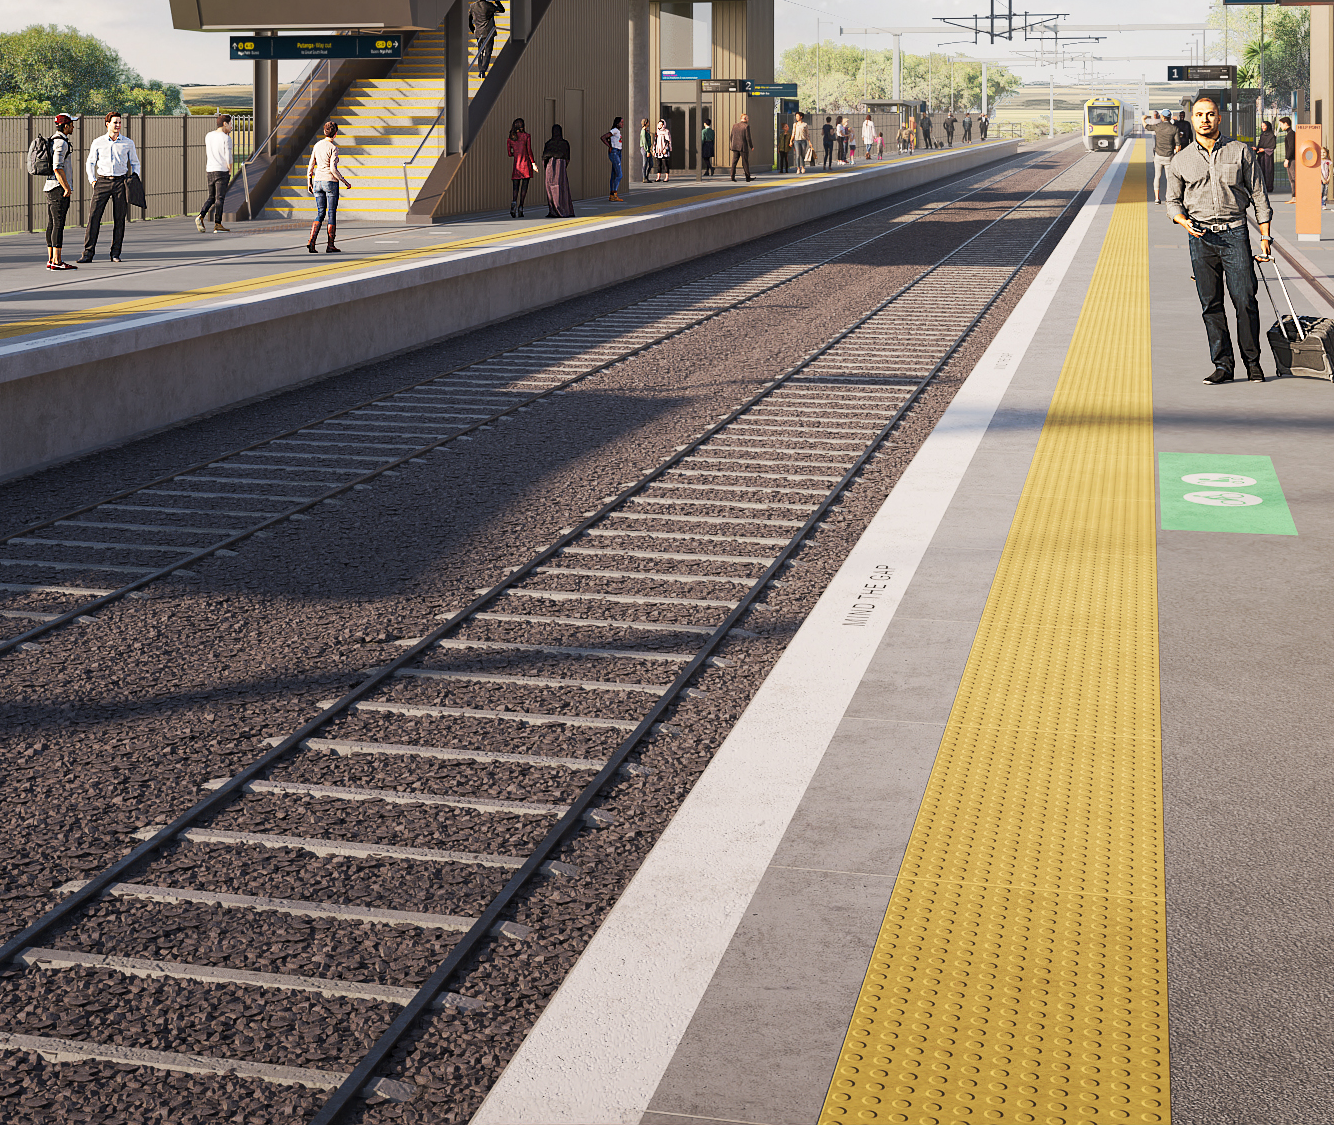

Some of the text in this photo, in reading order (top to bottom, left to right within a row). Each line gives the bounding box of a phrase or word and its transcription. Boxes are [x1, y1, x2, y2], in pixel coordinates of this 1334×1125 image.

[1172, 68, 1179, 78] 1
[745, 81, 752, 91] 2
[842, 565, 895, 626] MIND THE GAP
